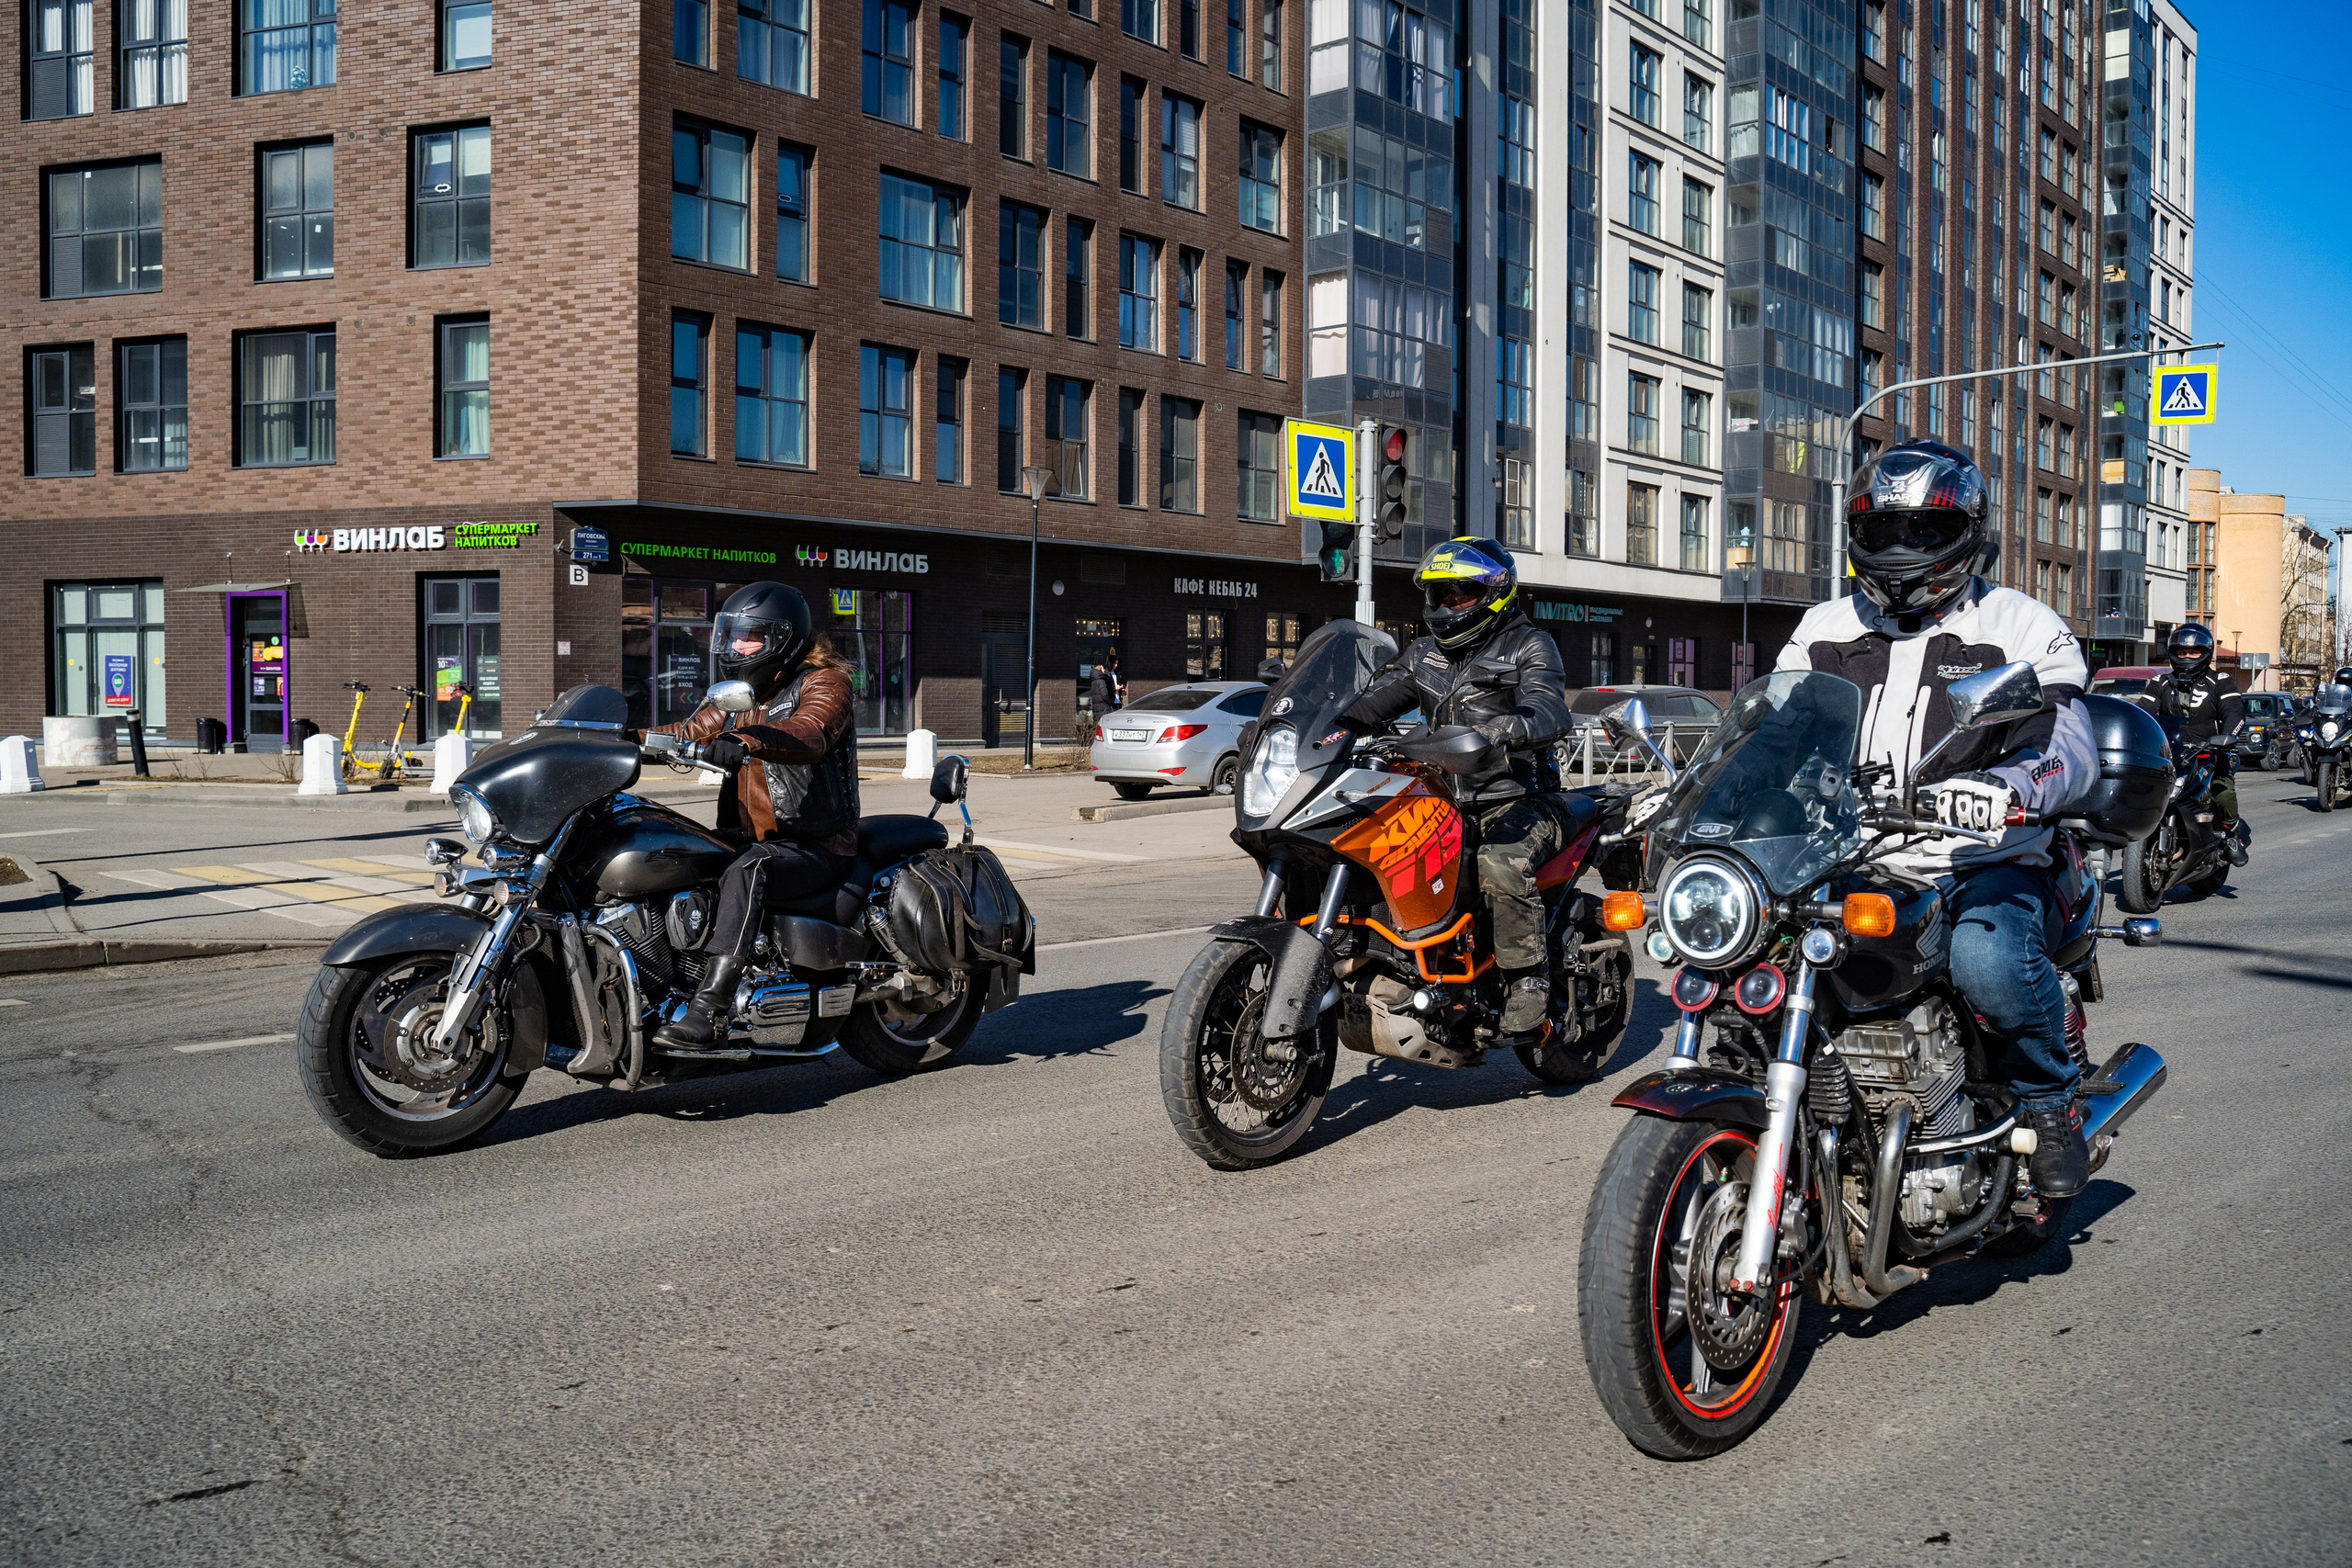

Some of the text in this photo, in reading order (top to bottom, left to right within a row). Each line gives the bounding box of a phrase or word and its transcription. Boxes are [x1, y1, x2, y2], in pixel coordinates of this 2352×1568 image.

[1876, 491, 1923, 503] SHARK
[455, 523, 537, 536] СУПЕРМАРКЕТ
[455, 536, 518, 547] НАПИТКОВ
[620, 542, 777, 564] СУПЕРМАРКЕТ НАПИТКОВ
[1430, 561, 1452, 570] SHOEI
[1173, 577, 1258, 598] КАФЕ КЕБАБ 24
[1533, 601, 1585, 622] INVITRO
[1368, 795, 1441, 863] KTM
[1696, 825, 1721, 834] GIVI
